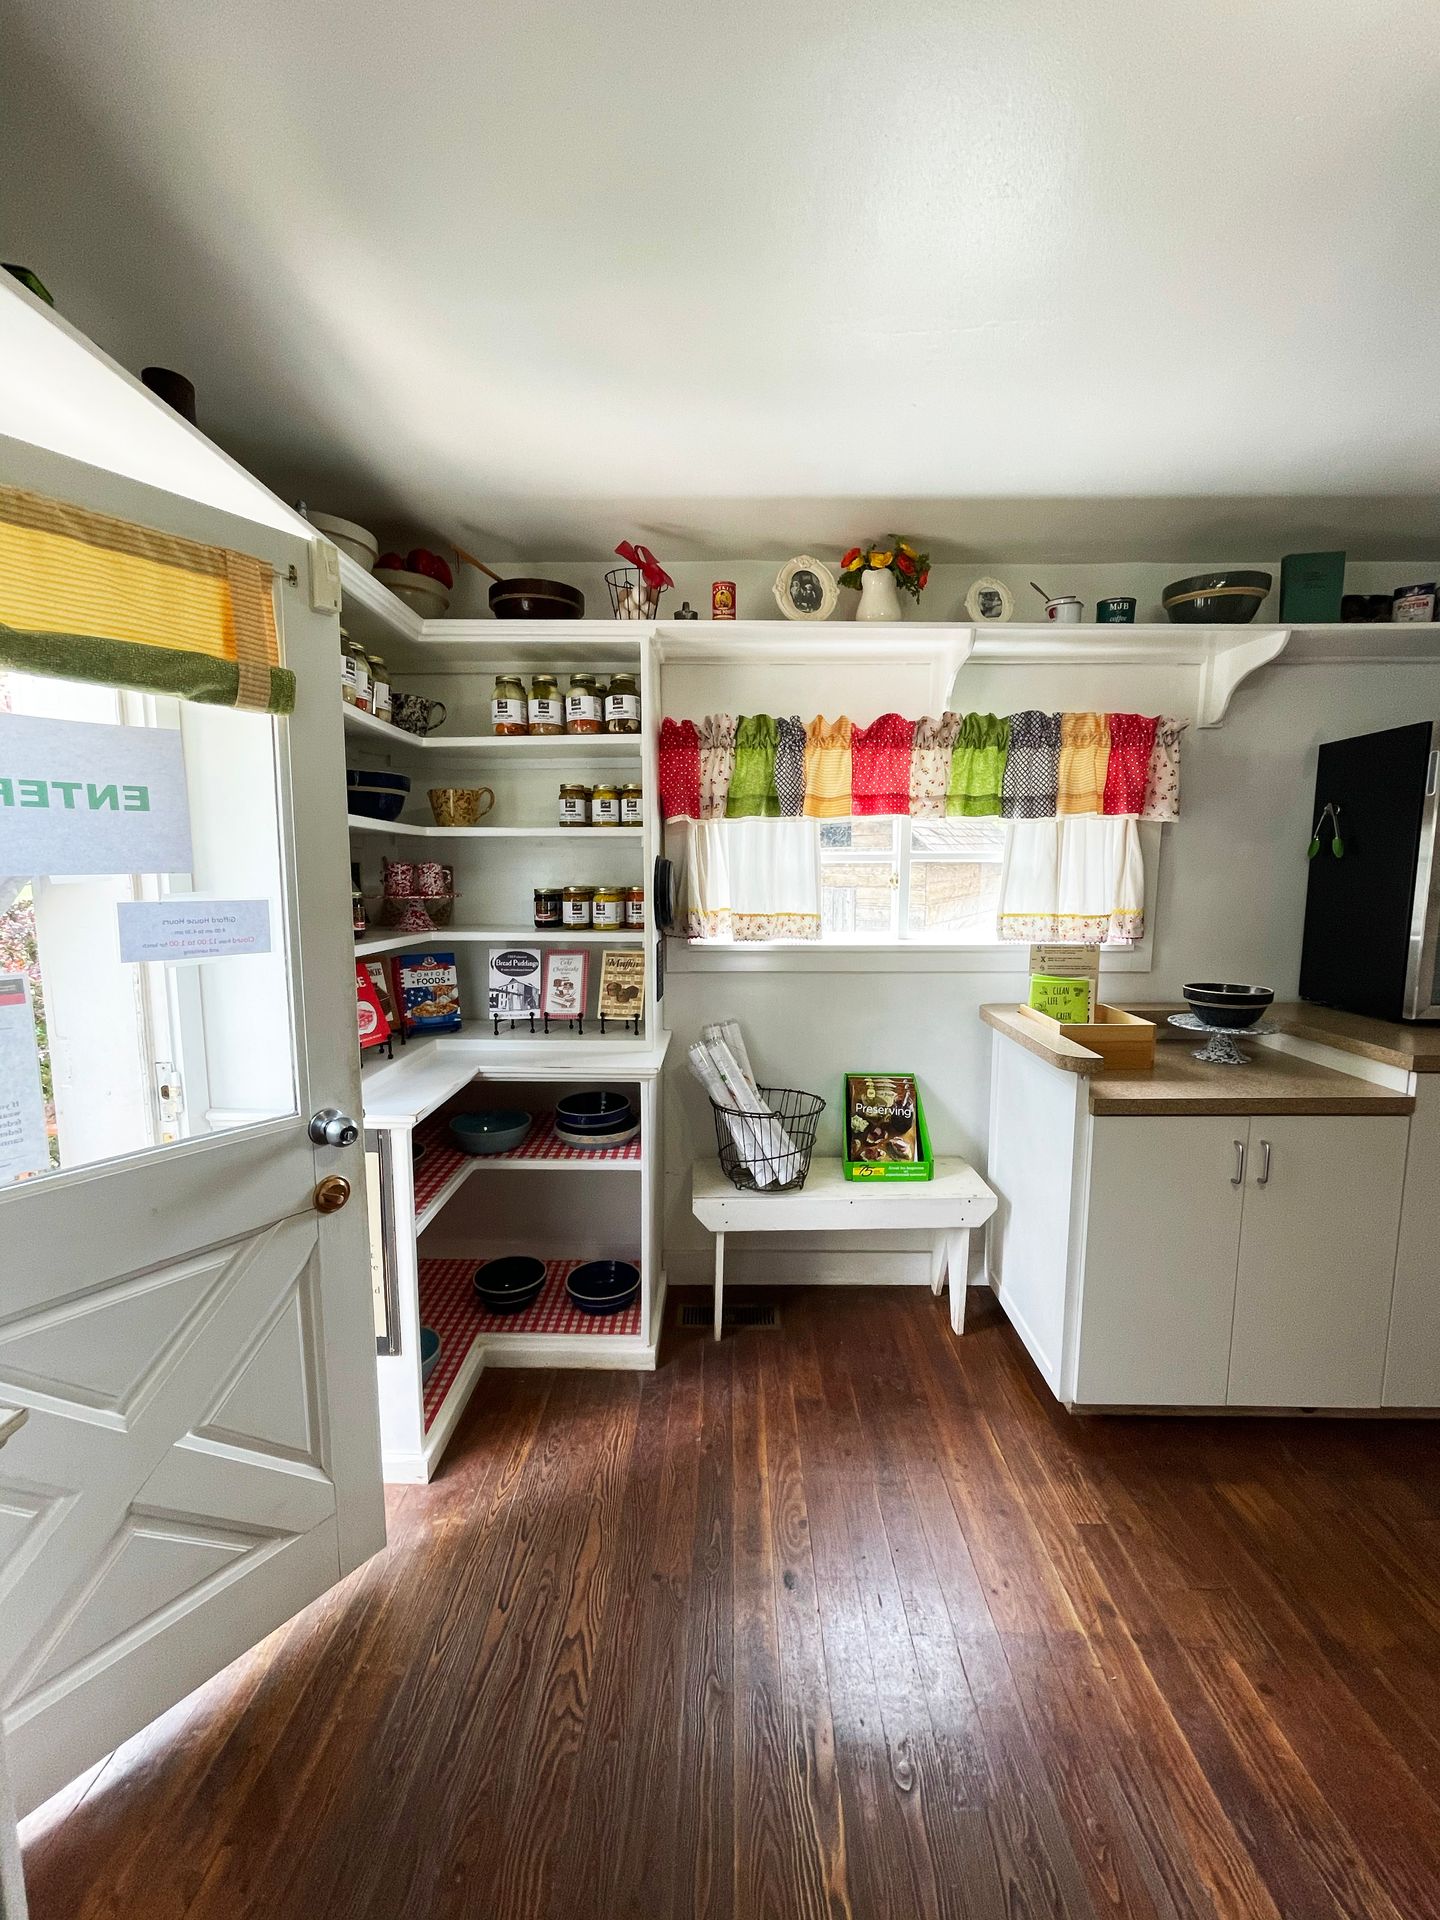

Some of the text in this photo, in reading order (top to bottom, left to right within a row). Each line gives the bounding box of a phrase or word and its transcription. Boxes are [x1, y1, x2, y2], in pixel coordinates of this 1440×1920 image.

[1109, 602, 1129, 611] MJB
[1109, 614, 1128, 623] coffee
[495, 958, 512, 967] Bread
[410, 970, 451, 979] COMFORT
[416, 977, 446, 986] FOODS
[1053, 987, 1069, 995] CLEAN
[1047, 997, 1058, 1005] LIFE
[855, 1103, 911, 1118] Preserving
